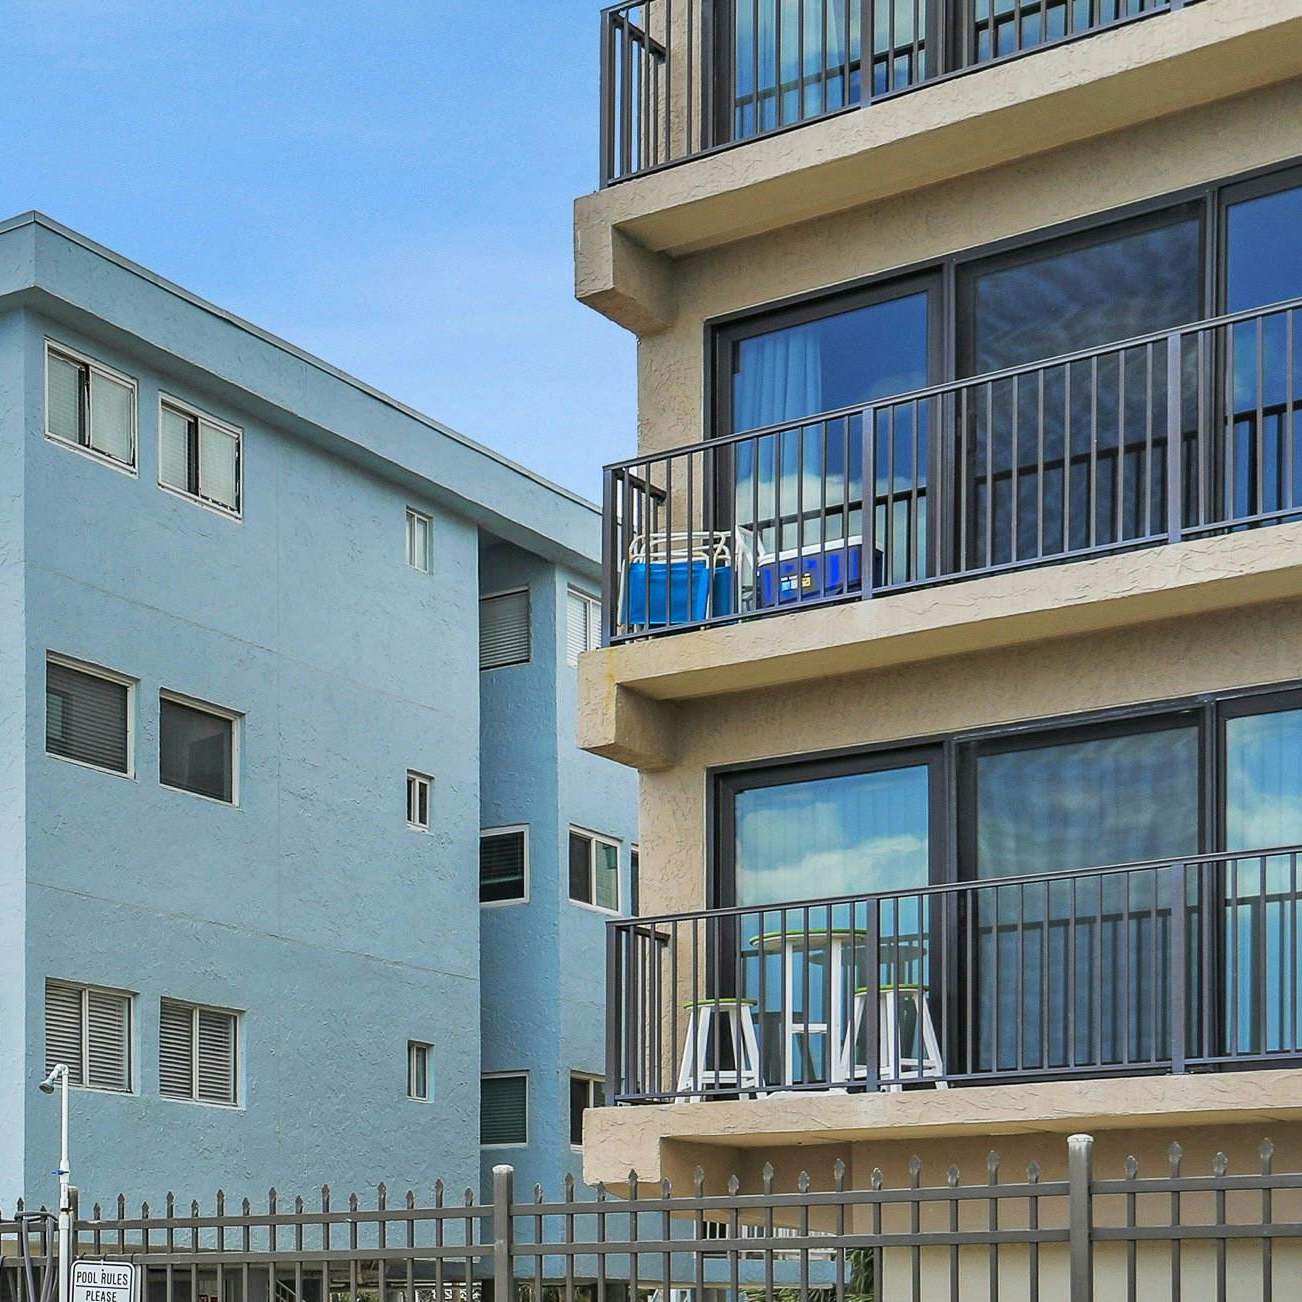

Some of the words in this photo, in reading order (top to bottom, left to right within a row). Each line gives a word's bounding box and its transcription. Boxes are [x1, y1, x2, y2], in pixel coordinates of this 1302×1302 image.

[76, 1271, 97, 1284] POOL
[101, 1272, 128, 1286] RULES
[86, 1290, 116, 1302] PLEASE
